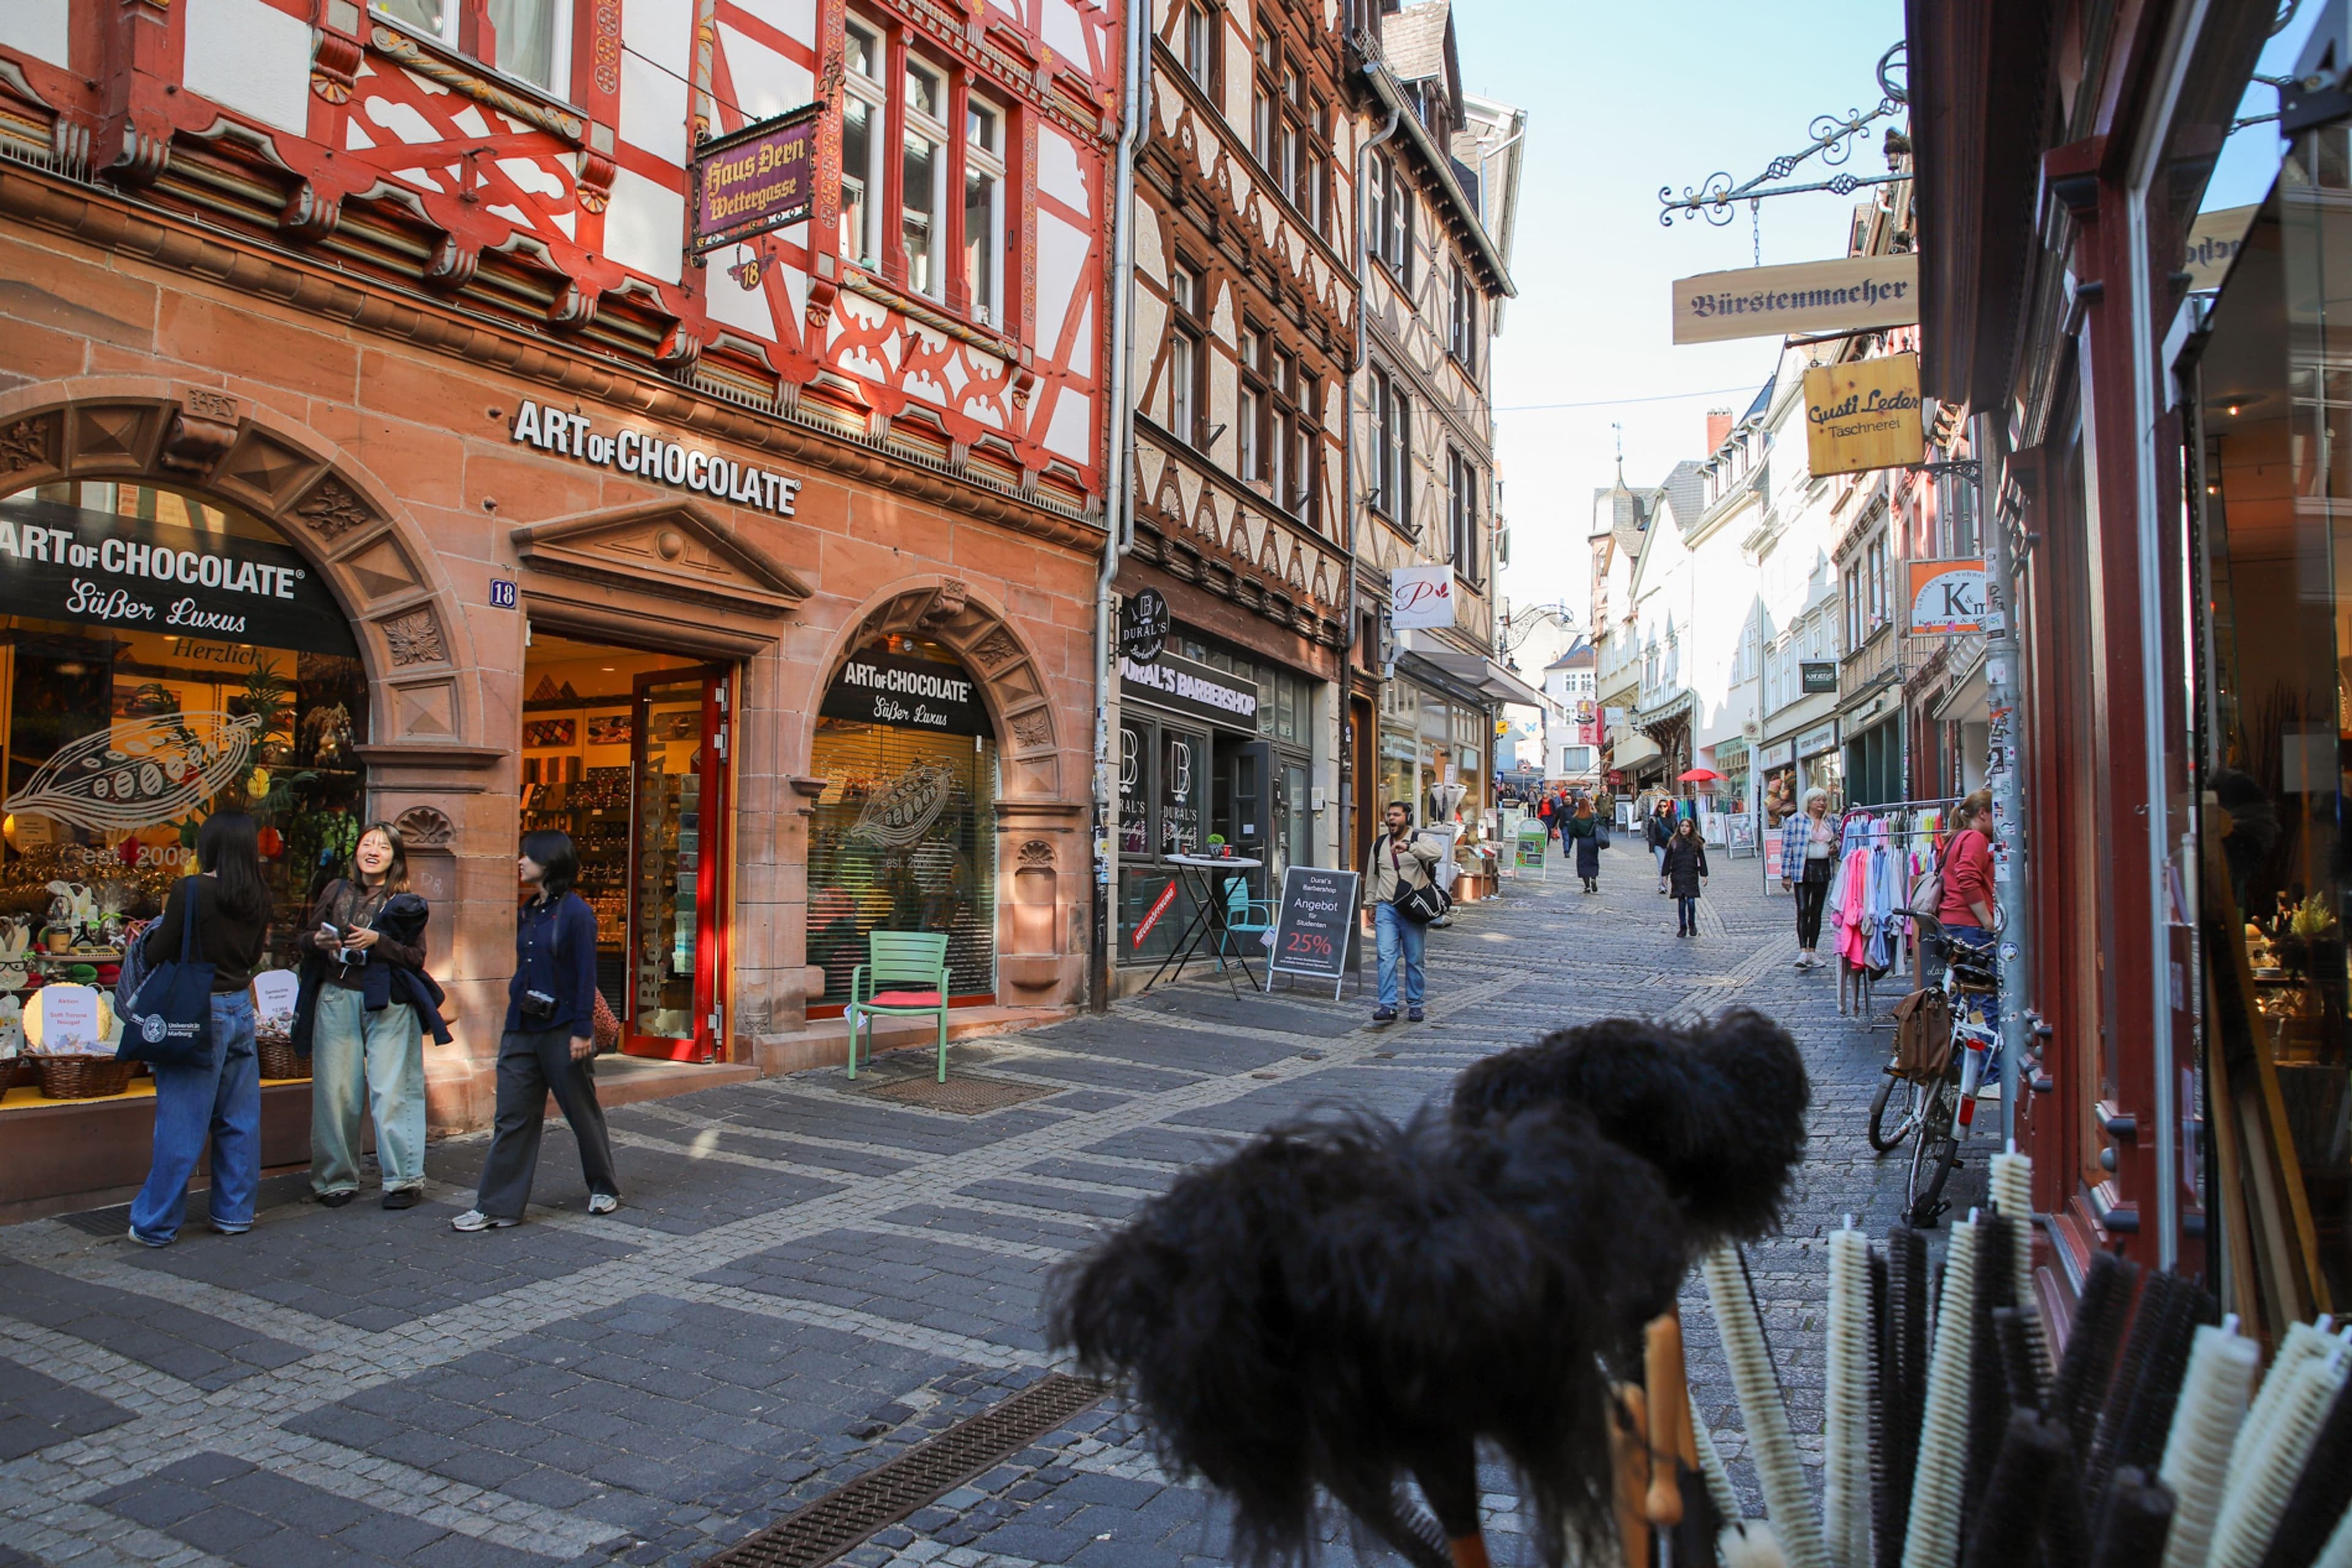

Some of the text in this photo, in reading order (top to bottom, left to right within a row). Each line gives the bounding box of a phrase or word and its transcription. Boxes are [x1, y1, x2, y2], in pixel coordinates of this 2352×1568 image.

[706, 138, 805, 201] Haus Dern
[709, 176, 797, 221] Wettergasse
[742, 262, 760, 287] 18
[1691, 278, 1908, 317] Bürstenmacher
[1809, 389, 1919, 424] Gusti Leder
[66, 578, 246, 633] Süßer Luxus
[494, 583, 513, 605] 18
[1941, 582, 1972, 616] K
[1124, 622, 1167, 641] DURAL'S
[173, 638, 262, 666] Herzlich
[1177, 672, 1256, 716] BARBERSHOP
[873, 695, 948, 726] Süßer Luxus
[1164, 805, 1197, 821] DURAL'S
[82, 846, 192, 867] est. 2008
[1294, 897, 1338, 911] Angebot
[1296, 919, 1327, 928] Studenten
[1287, 932, 1332, 955] 25%
